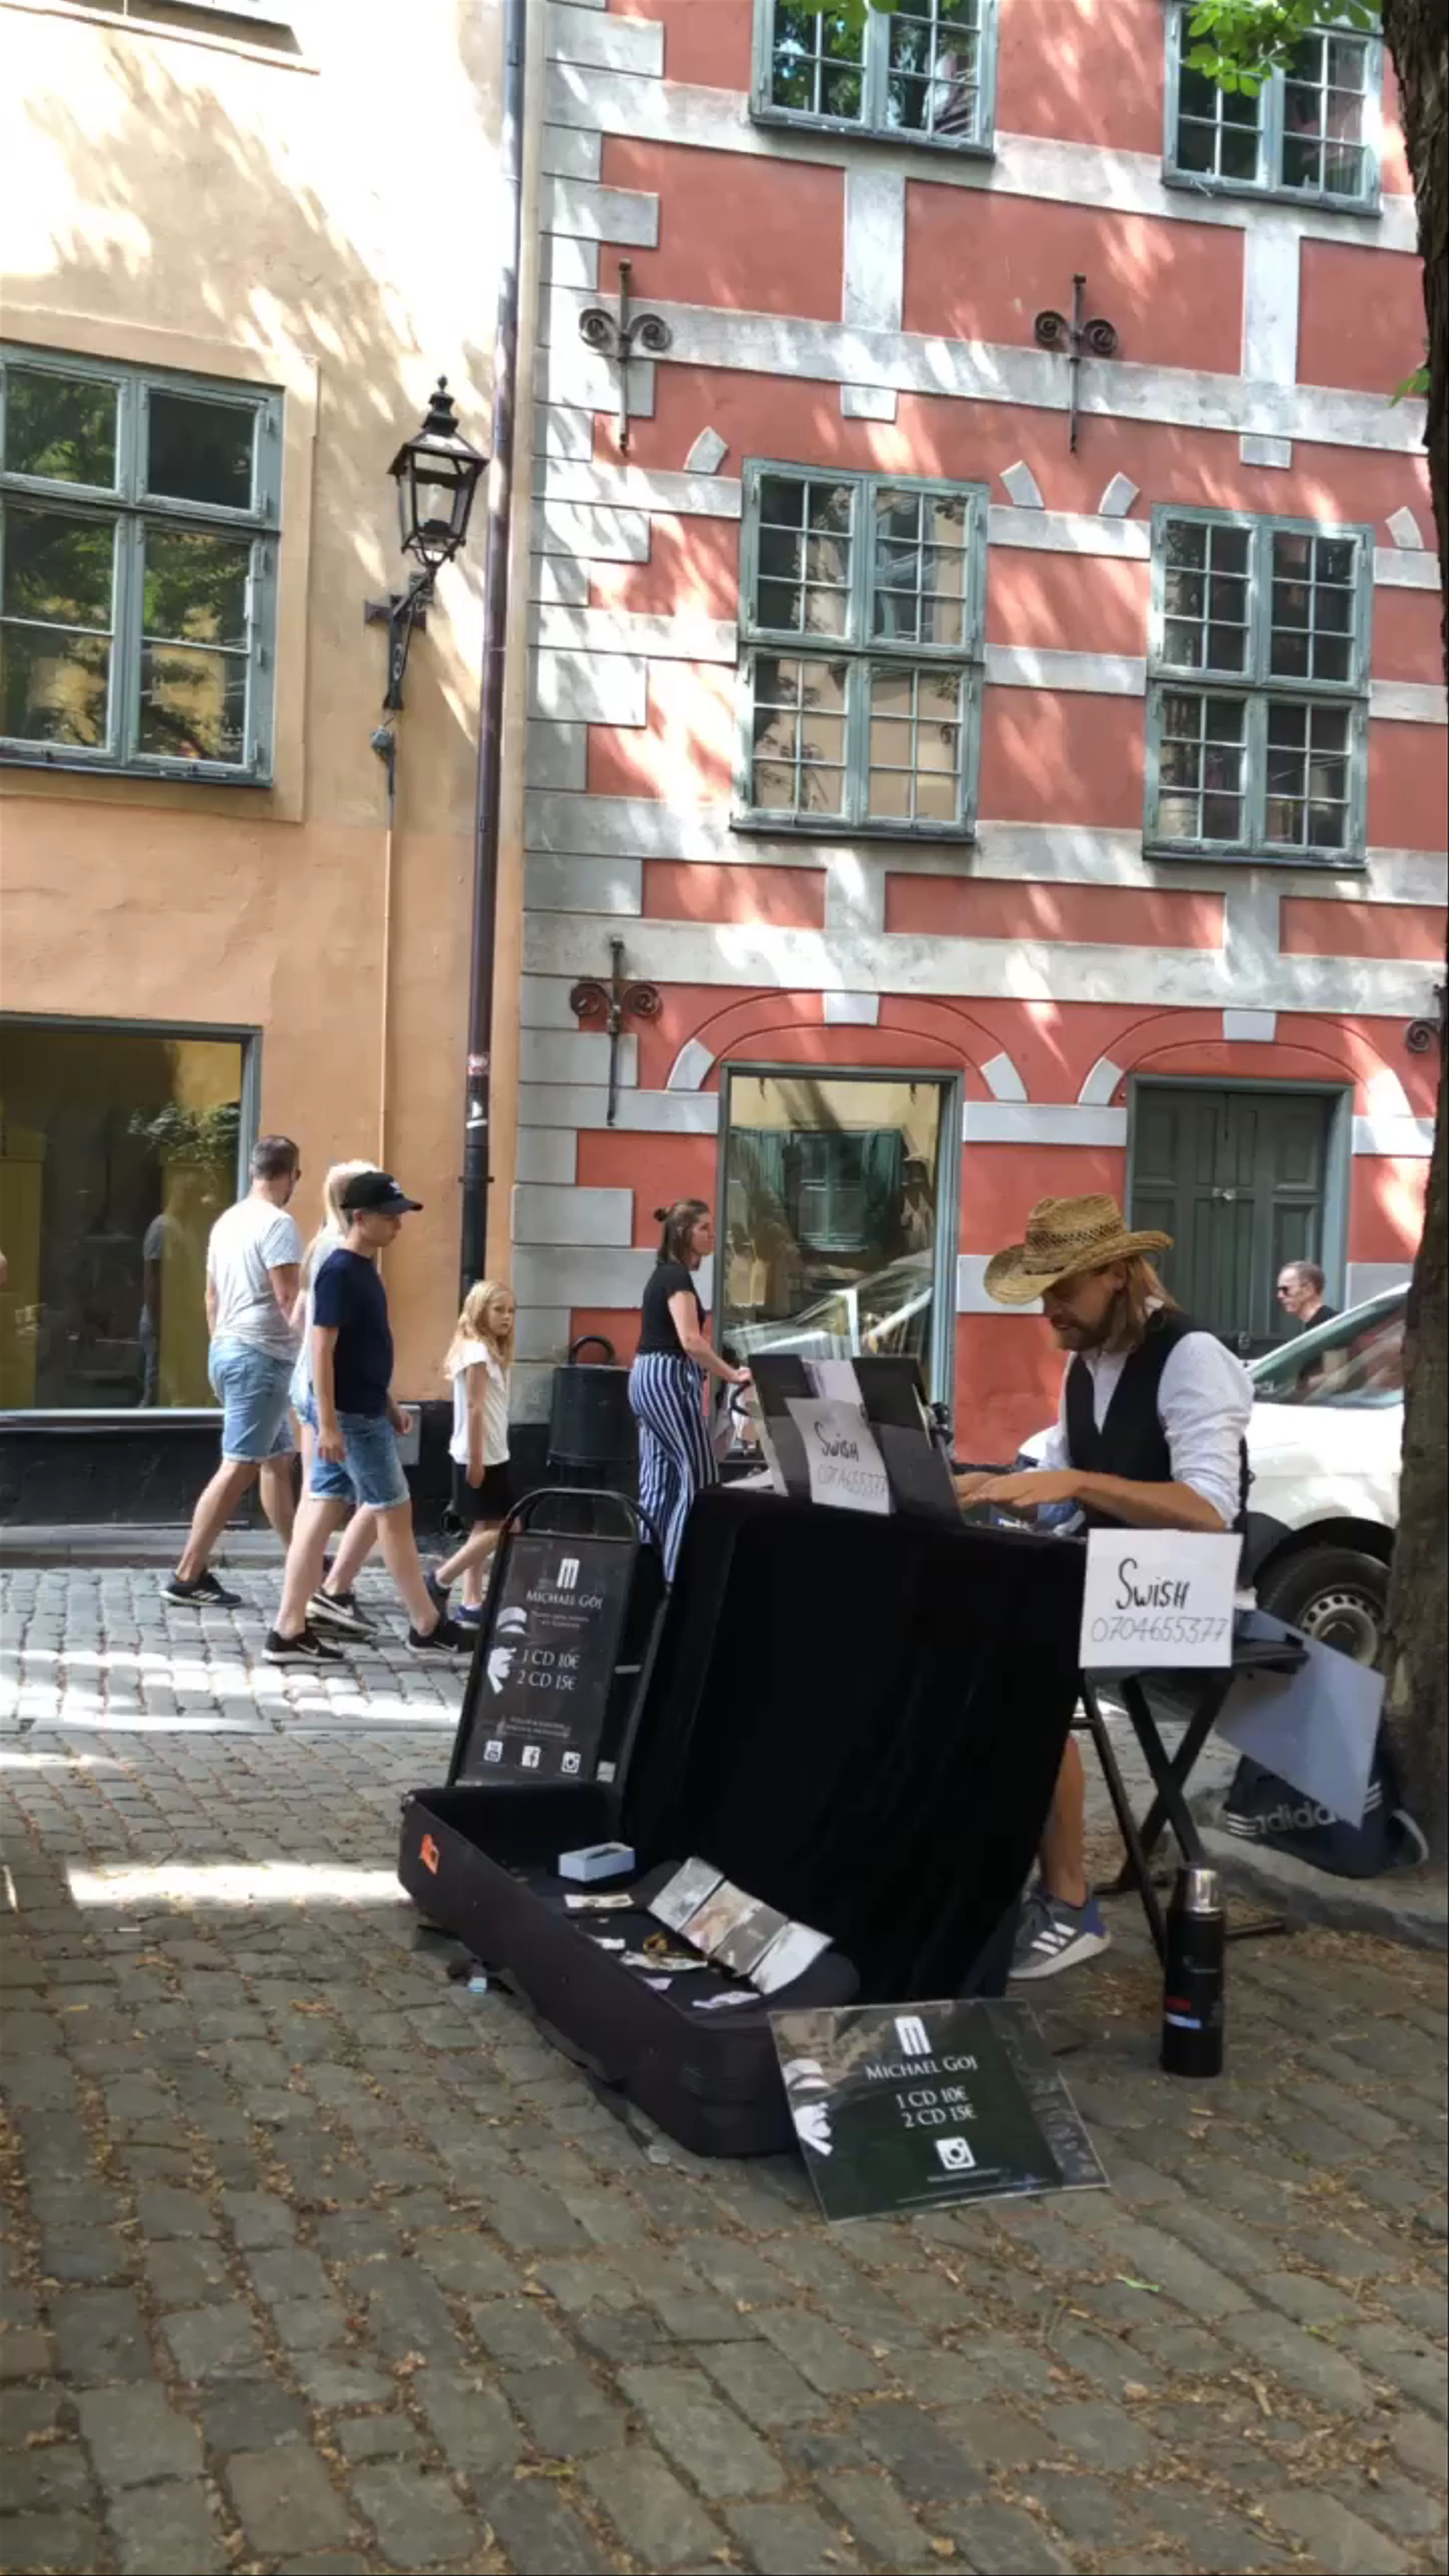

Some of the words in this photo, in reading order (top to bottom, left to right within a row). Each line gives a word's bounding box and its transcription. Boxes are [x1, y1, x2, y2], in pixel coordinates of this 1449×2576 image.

[526, 1590, 575, 1606] MICHAEL
[1091, 1616, 1229, 1644] 0704655377
[522, 1649, 529, 1664] 1
[531, 1649, 555, 1666] CD
[516, 1670, 526, 1684] 2
[528, 1672, 552, 1688] CD
[865, 2060, 941, 2080] MICHAEL
[942, 2055, 978, 2072] GOJ
[896, 2093, 906, 2109] 1
[908, 2090, 937, 2107] CD
[940, 2085, 969, 2103] 10€
[901, 2112, 916, 2128] 2
[917, 2108, 946, 2125] CD
[949, 2104, 977, 2122] 15€
